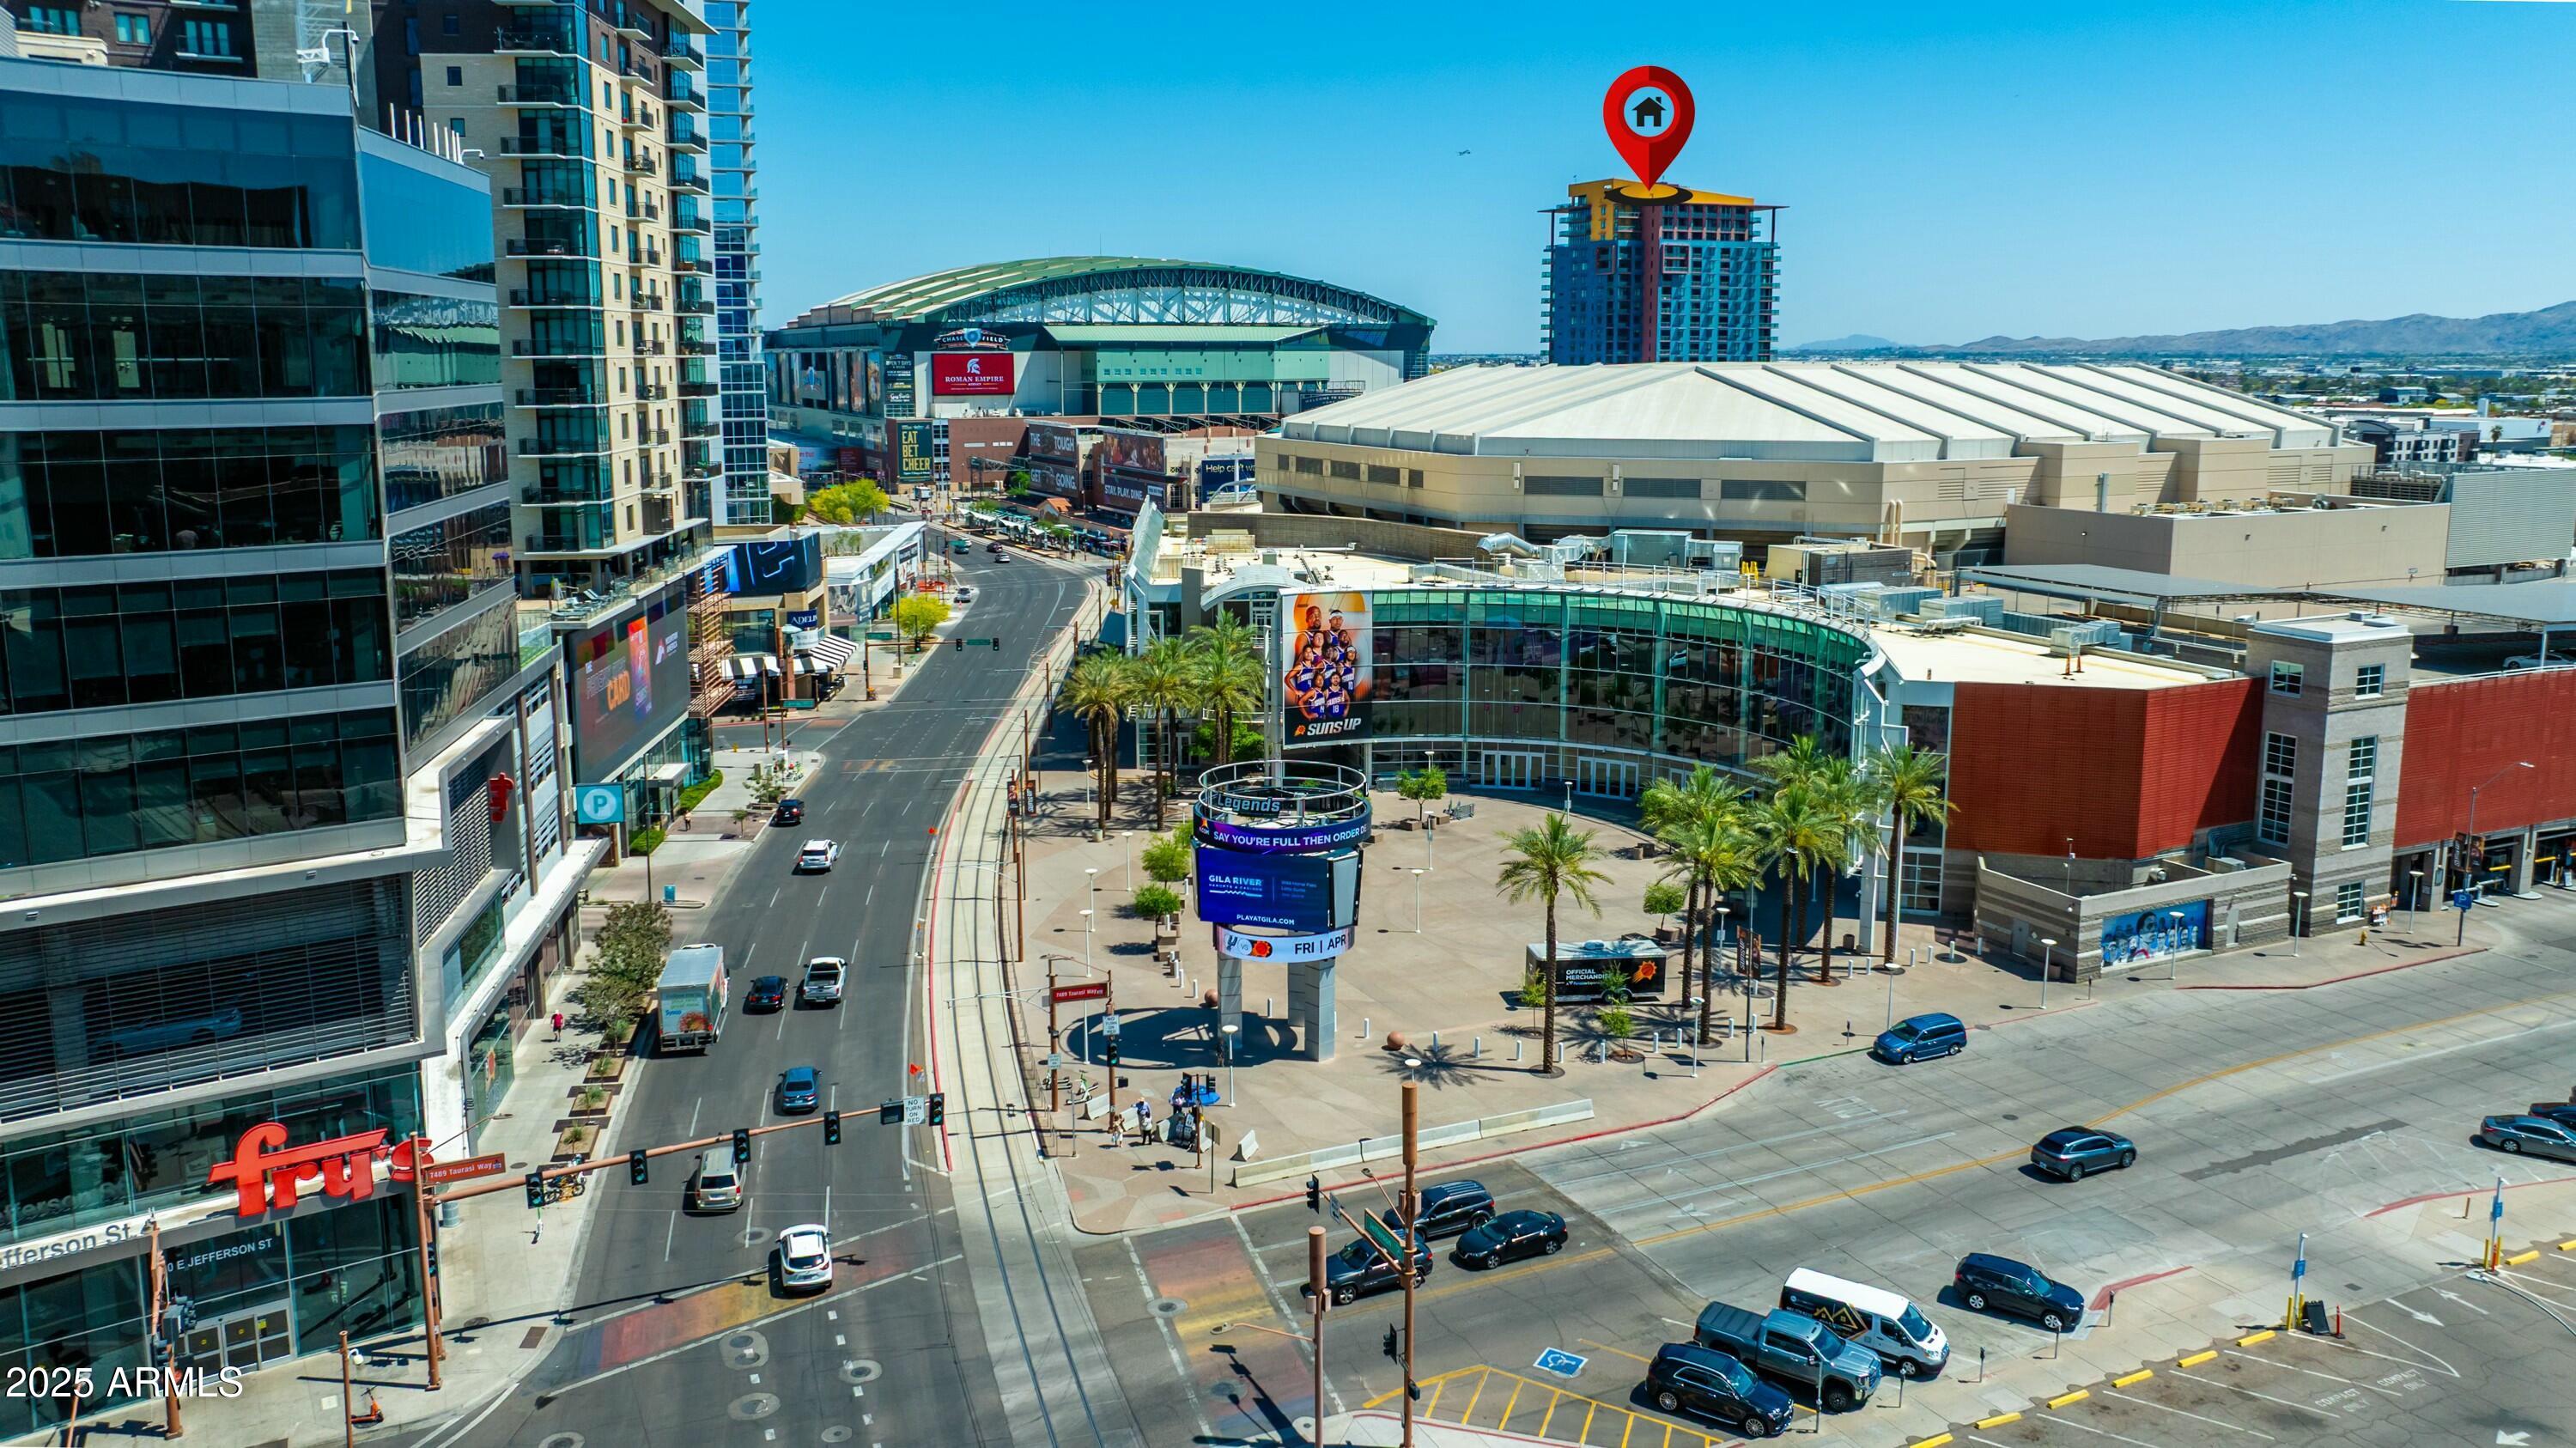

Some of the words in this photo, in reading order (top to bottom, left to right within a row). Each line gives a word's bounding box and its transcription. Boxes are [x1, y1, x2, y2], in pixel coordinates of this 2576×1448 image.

[902, 431, 918, 444] EAT
[1030, 433, 1040, 447] THE
[1054, 435, 1074, 452] TOUGH
[902, 444, 919, 457] BET
[902, 458, 930, 471] CHEER
[1206, 464, 1225, 473] Help
[1031, 469, 1042, 482] GET
[1056, 473, 1077, 490] GOING.
[606, 671, 630, 711] CARD
[1333, 705, 1339, 714] 18
[1344, 718, 1362, 730] UP
[593, 795, 608, 813] P
[1218, 794, 1280, 813] Legends
[1213, 830, 1230, 843] SAY
[1232, 833, 1270, 847] YOU'RE
[1273, 837, 1301, 847] FULL
[1303, 835, 1331, 845] THEN
[1333, 828, 1360, 843] ORDER
[1209, 875, 1230, 884] GILA
[1233, 877, 1262, 886] RIVER
[1236, 914, 1295, 925] PLAYATGILA.COM
[1295, 942, 1315, 954] FRI
[1327, 934, 1346, 950] APR
[449, 1165, 475, 1175] Taurasi
[477, 1163, 492, 1171] Way
[0, 1233, 96, 1270] fferson
[105, 1223, 131, 1245] St
[176, 1259, 185, 1270] E
[188, 1243, 256, 1268] JEFFERSON
[258, 1238, 273, 1250] ST
